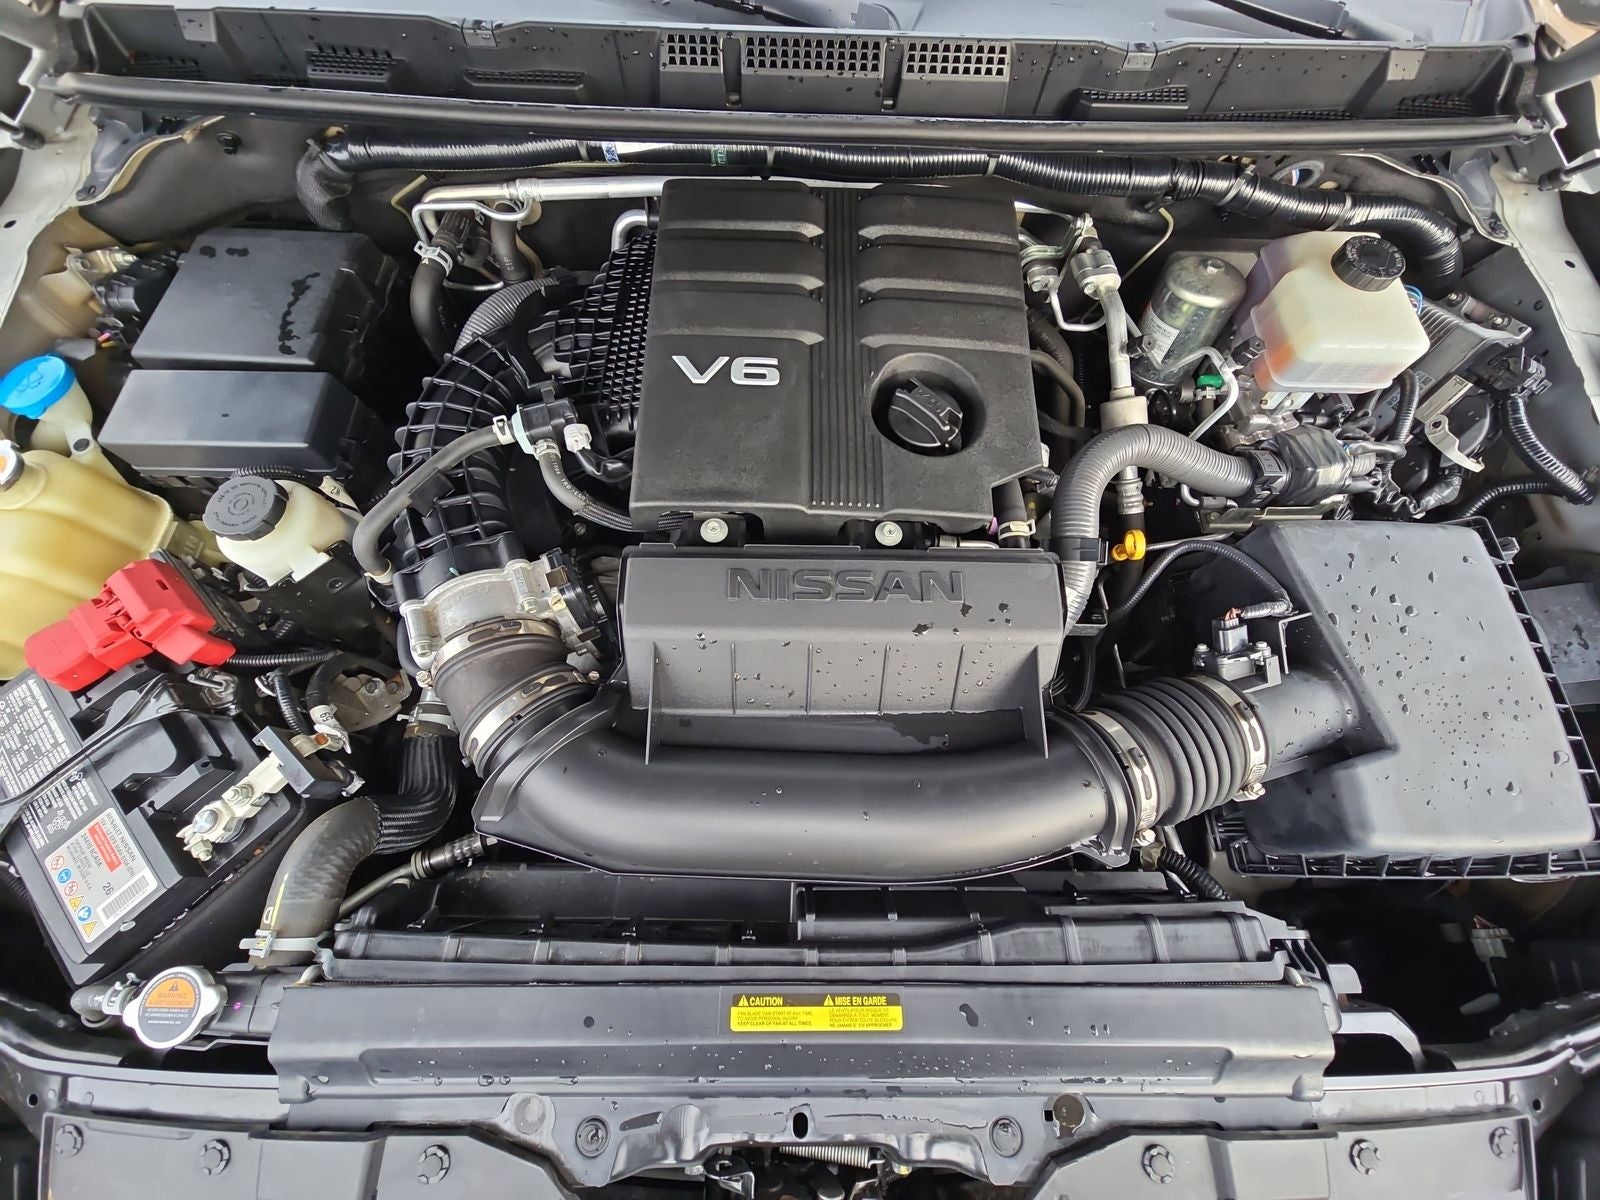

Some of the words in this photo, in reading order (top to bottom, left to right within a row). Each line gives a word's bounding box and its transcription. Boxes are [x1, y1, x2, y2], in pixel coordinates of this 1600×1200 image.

[671, 354, 781, 387] V6
[727, 567, 965, 602] NISSAN
[119, 836, 137, 861] NISSAN
[102, 881, 114, 896] 26
[749, 996, 783, 1006] CAUTION
[834, 996, 851, 1006] MISE
[852, 996, 862, 1006] EN
[862, 996, 887, 1006] GARDE
